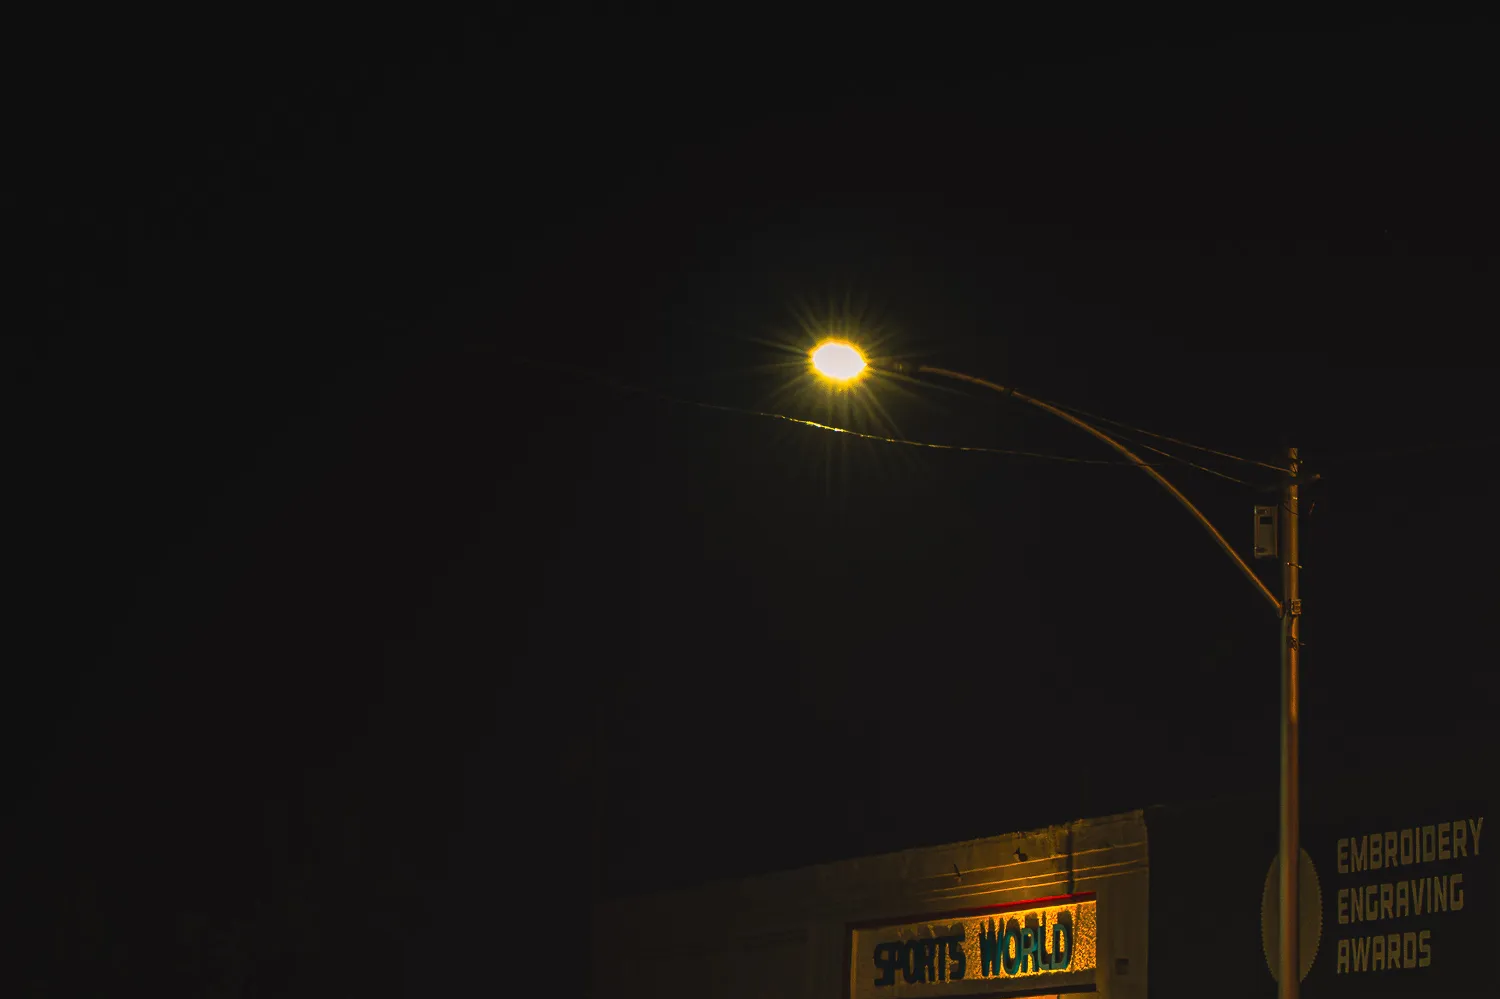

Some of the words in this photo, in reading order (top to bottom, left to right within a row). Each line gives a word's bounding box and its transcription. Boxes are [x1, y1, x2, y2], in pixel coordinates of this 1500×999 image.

[1337, 816, 1484, 874] EMBROIDERY
[1337, 873, 1465, 925] ENGRAVING
[873, 934, 966, 987] SPORTS
[979, 918, 1074, 977] WORLD
[1337, 929, 1432, 975] AWARDS
